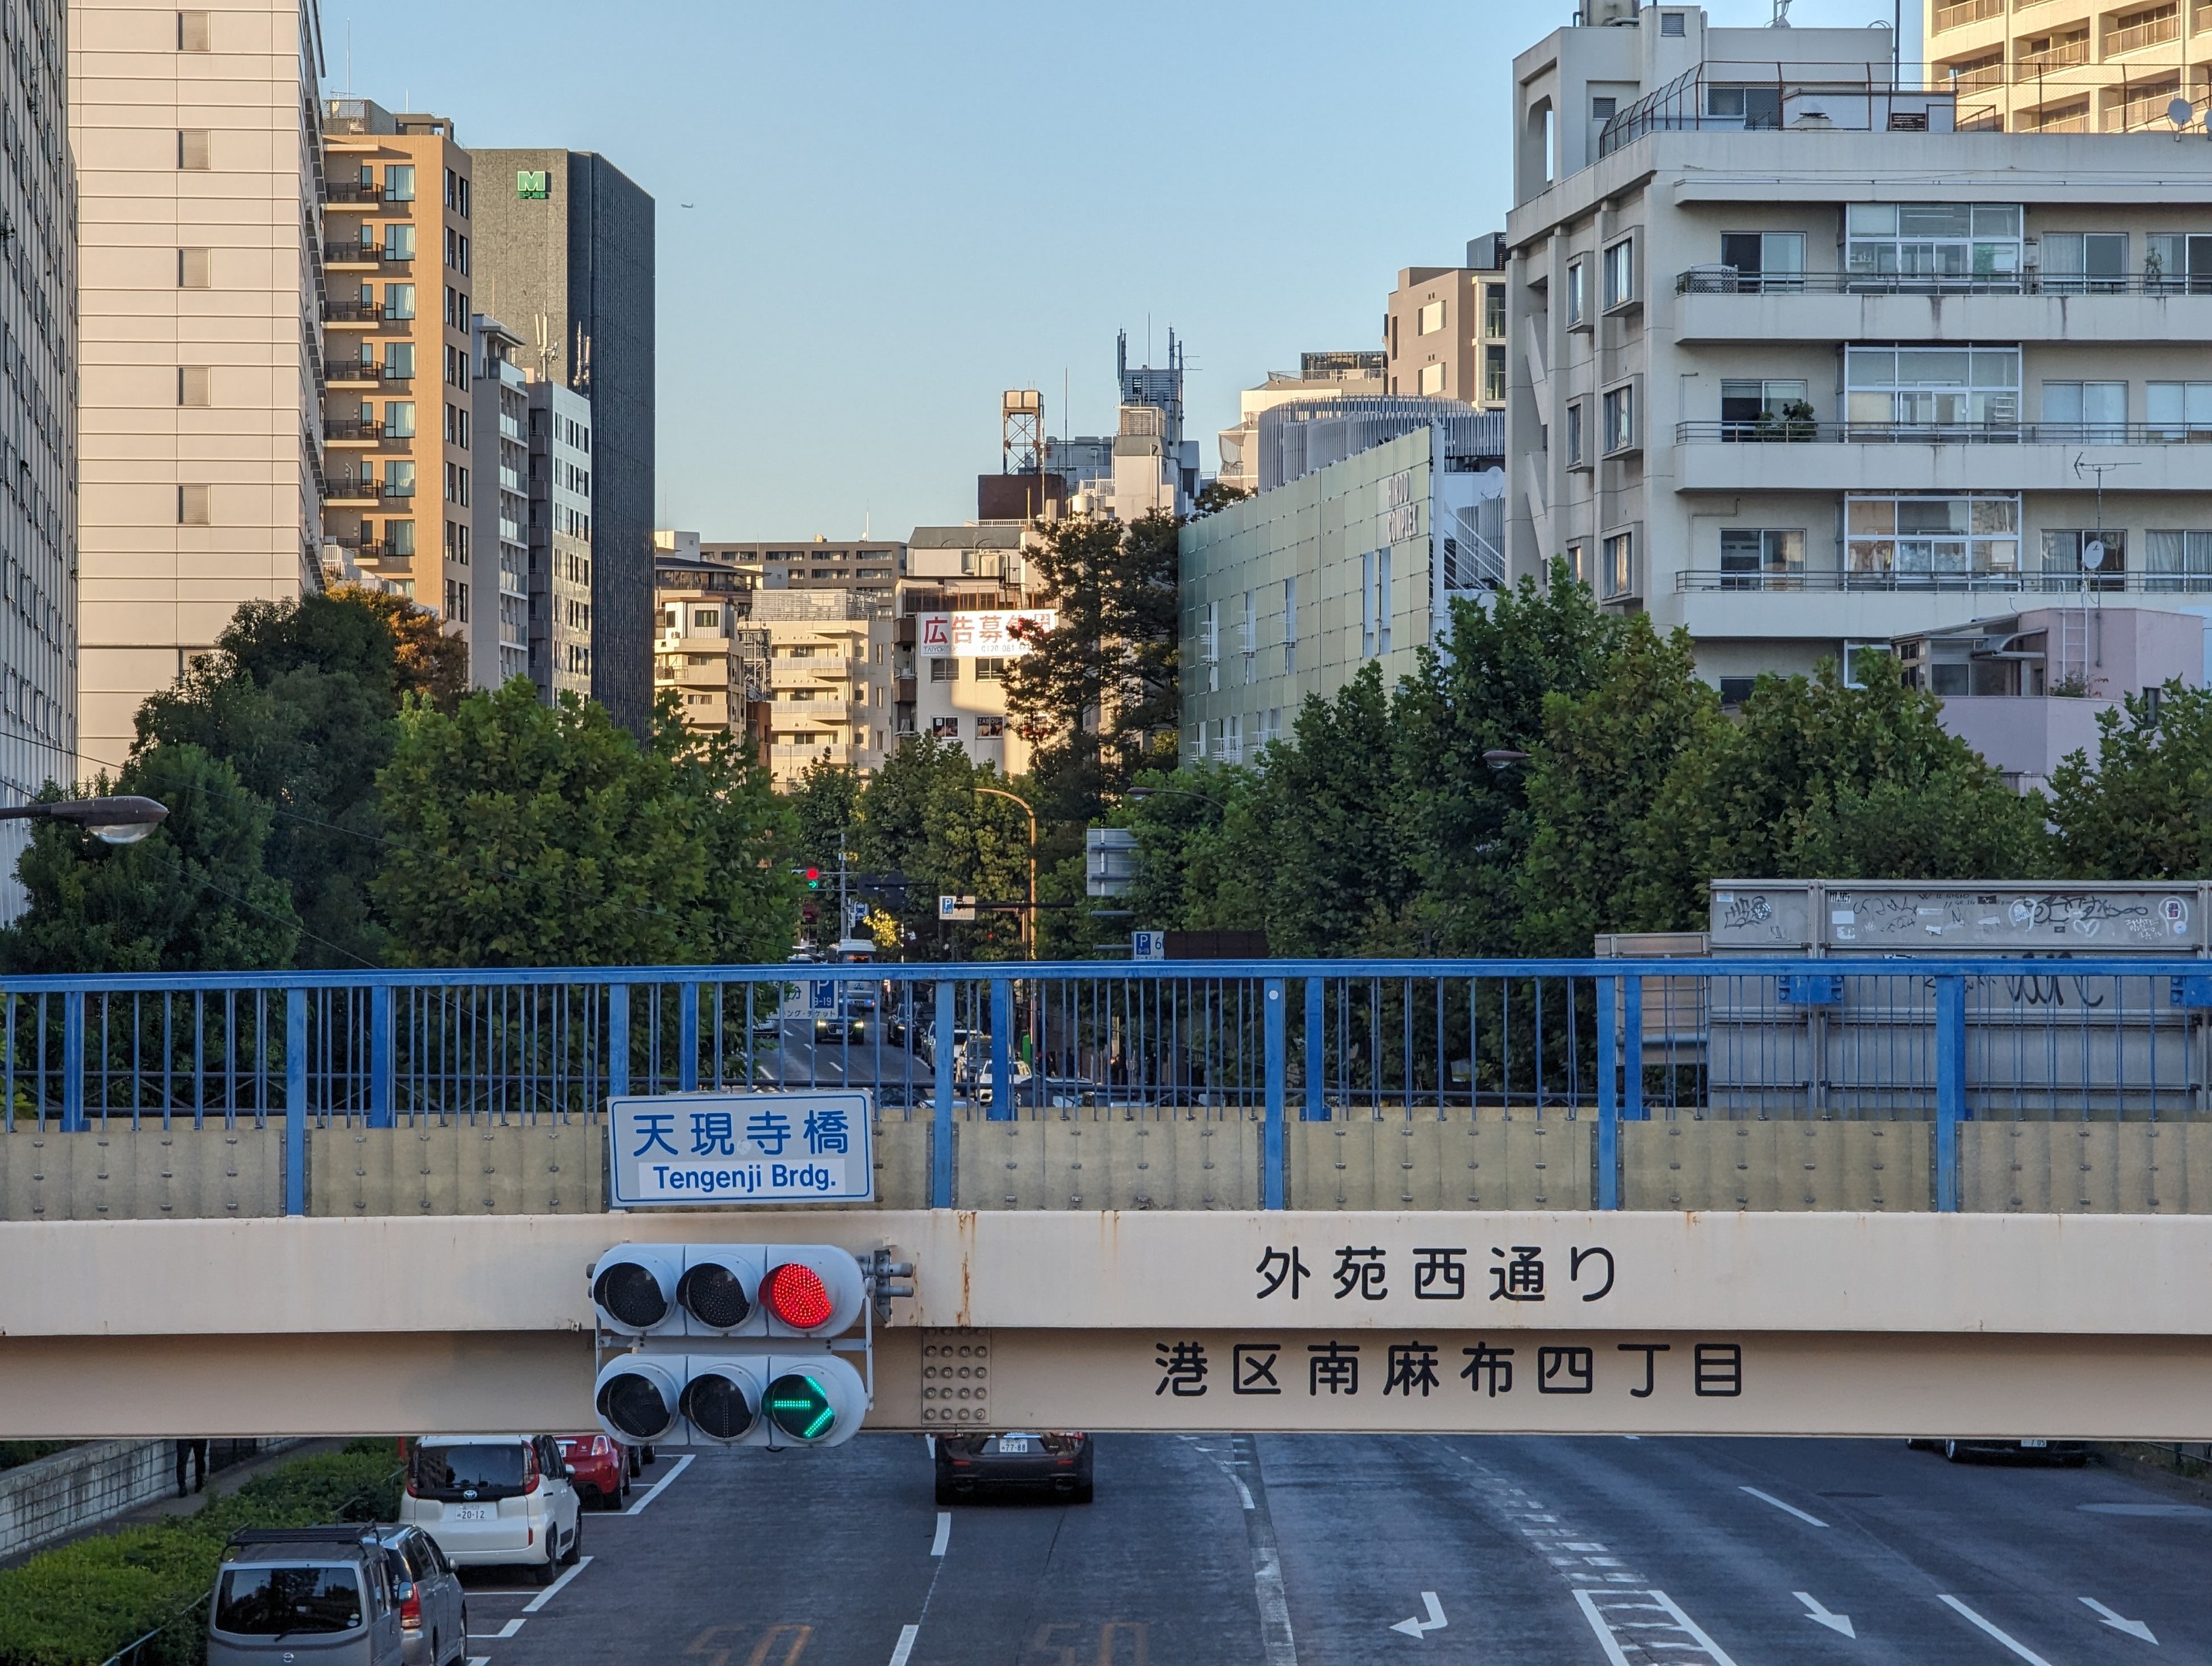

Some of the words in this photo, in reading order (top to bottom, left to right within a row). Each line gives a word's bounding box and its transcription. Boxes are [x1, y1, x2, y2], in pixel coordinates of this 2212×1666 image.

[1388, 471, 1411, 508] HIROO
[1388, 504, 1419, 543] COMPLEX
[1140, 935, 1148, 947] P
[1155, 937, 1165, 949] 6
[633, 1109, 849, 1157] 天現寺橋
[652, 1164, 762, 1193] Tengenji
[772, 1163, 836, 1192] Brdg.
[1256, 1245, 1615, 1302] 外苑西通り
[1155, 1340, 1742, 1398] 港区南麻布四丁目
